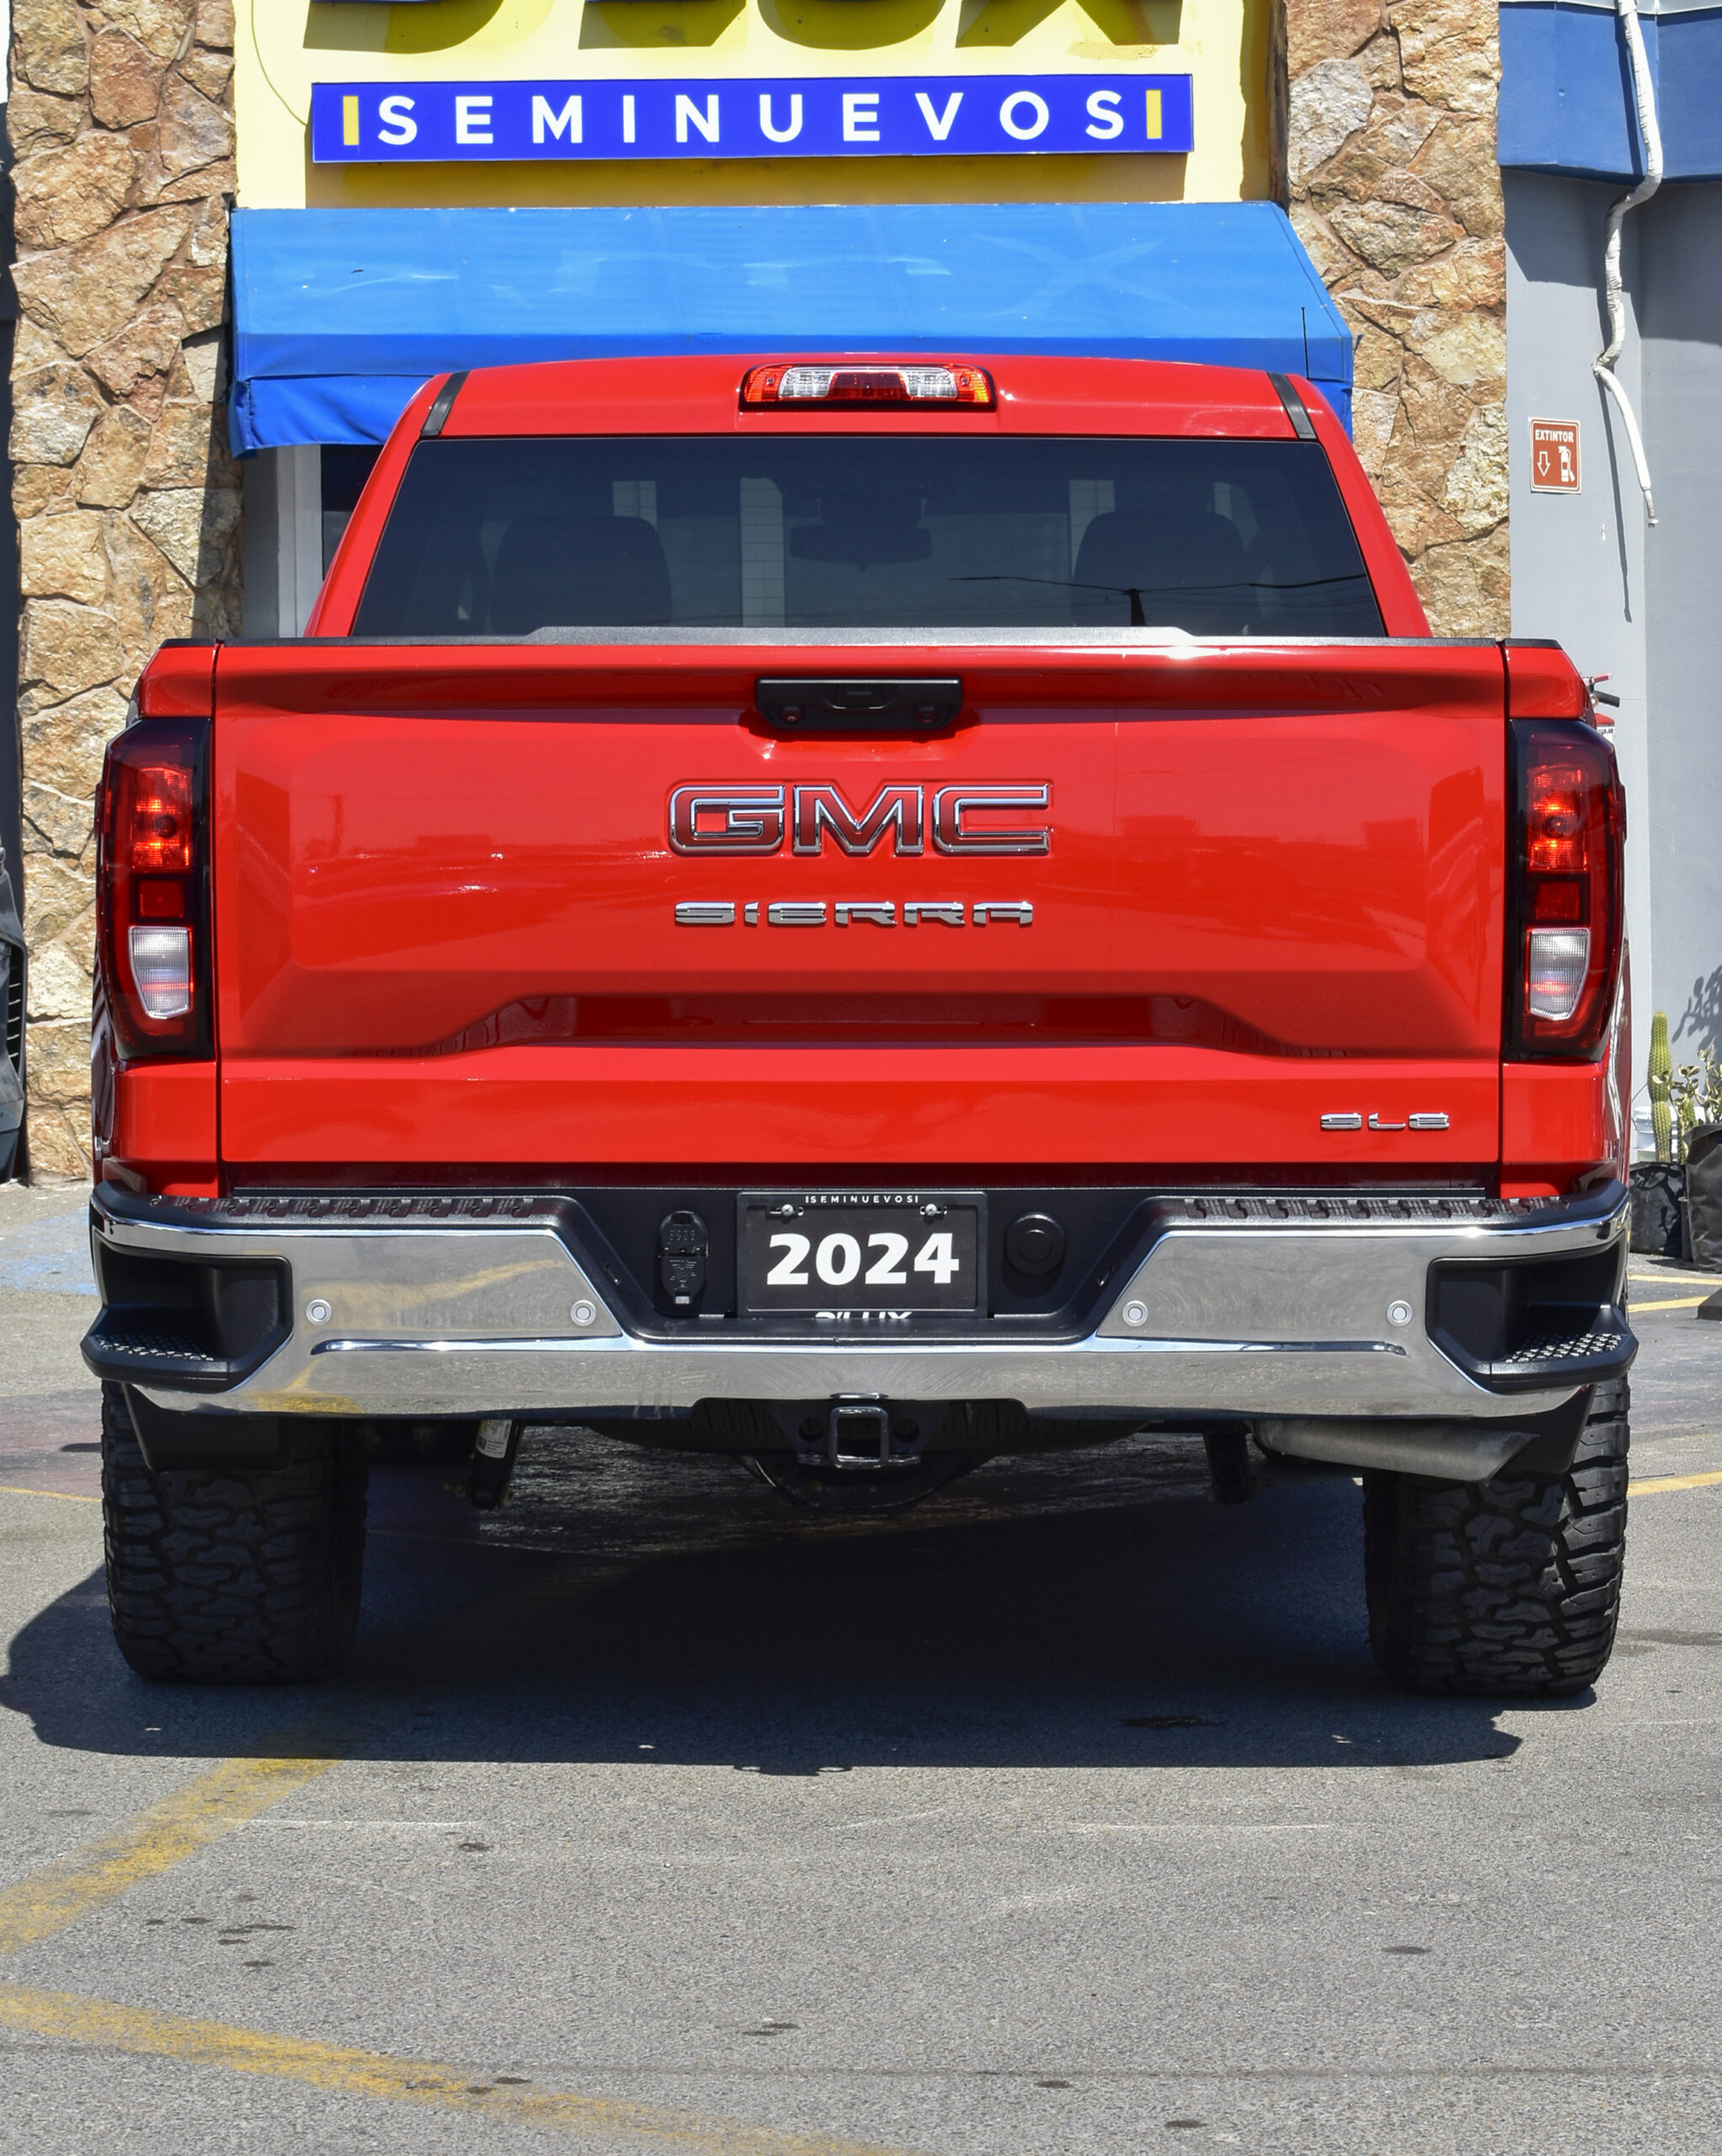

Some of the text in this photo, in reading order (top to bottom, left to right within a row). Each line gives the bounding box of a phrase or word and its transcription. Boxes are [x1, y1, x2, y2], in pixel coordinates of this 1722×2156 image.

[1535, 429, 1574, 442] EXTINTOR
[669, 782, 1050, 856] GMC
[675, 900, 1034, 926] SIERRA
[1320, 1112, 1450, 1129] SLE
[766, 1232, 960, 1286] 2024
